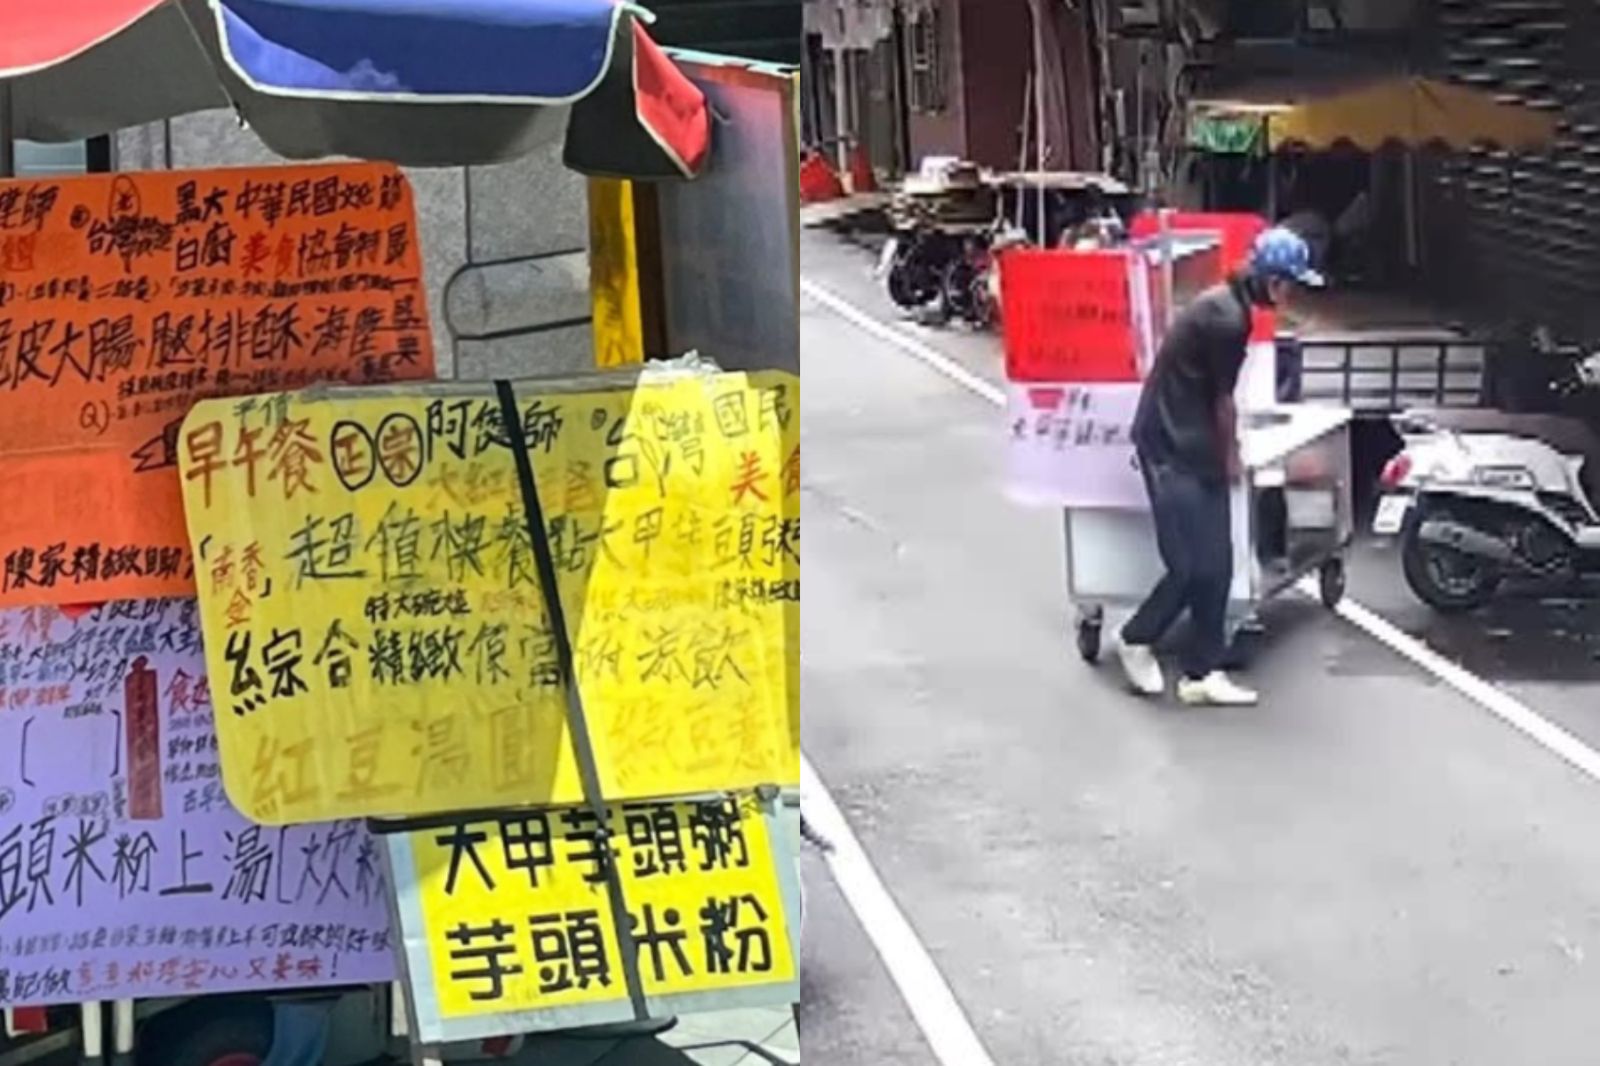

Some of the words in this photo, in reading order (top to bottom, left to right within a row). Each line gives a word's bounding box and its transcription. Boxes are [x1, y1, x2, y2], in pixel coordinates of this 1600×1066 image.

[185, 415, 324, 509] 早午餐
[331, 416, 423, 488] 正宗
[252, 712, 537, 820] 紅豆湯圓
[435, 797, 749, 896] 大甲芋頭粥
[444, 892, 773, 1001] 芋頭米粉
